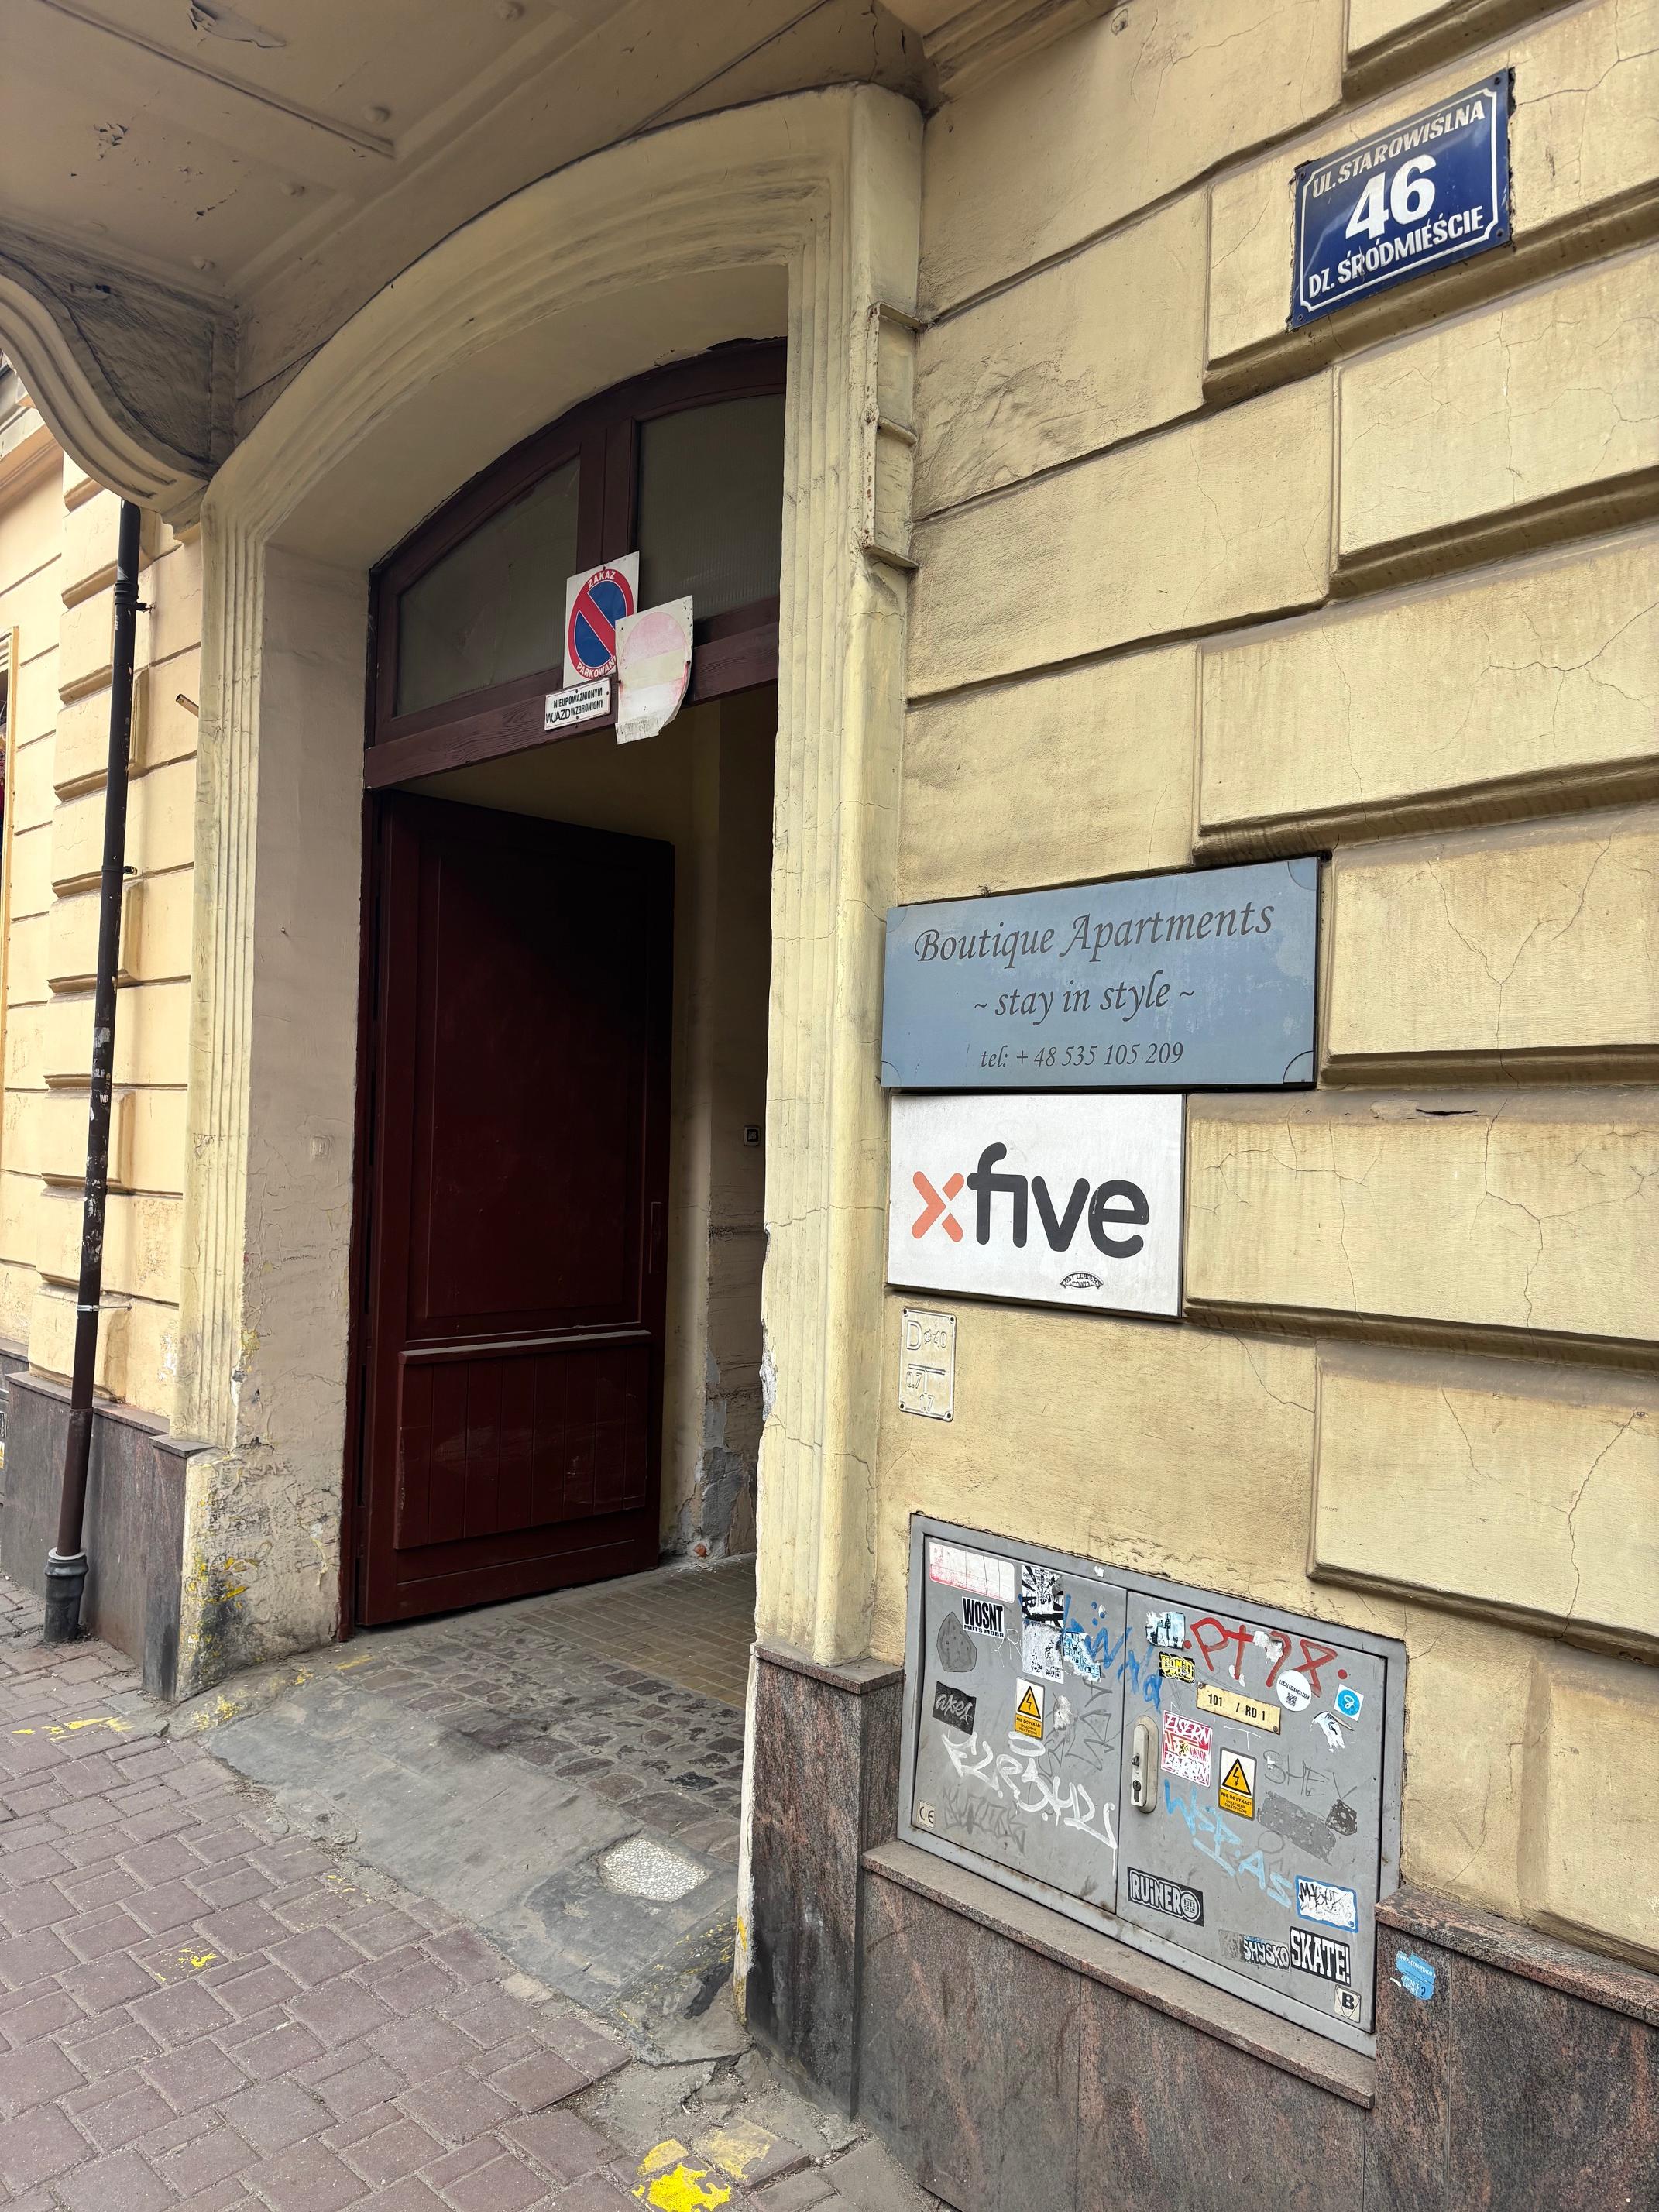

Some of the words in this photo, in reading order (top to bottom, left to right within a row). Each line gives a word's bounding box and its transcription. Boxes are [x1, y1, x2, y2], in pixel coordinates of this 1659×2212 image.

[1312, 175, 1336, 199] UL.
[1338, 100, 1486, 184] STAROWIŚLNA
[1345, 154, 1437, 240] 46
[1308, 271, 1335, 299] DZ.
[1338, 205, 1484, 284] ŚRÓDMIEŚCIE
[587, 571, 616, 589] ZAKAZ
[576, 655, 617, 678] PARKOWAN
[553, 687, 603, 709] NIEUPOWAŻNIONYM
[545, 708, 571, 723] WJAZD
[915, 921, 1054, 970] Boutique
[1059, 901, 1275, 963] Apartments
[994, 990, 1053, 1026] stay
[1063, 979, 1091, 1012] in
[1098, 970, 1170, 1022] style
[1033, 1048, 1056, 1067] 48
[1061, 1045, 1096, 1066] 535
[1104, 1044, 1139, 1065] 105
[1145, 1042, 1183, 1066] 209
[912, 1142, 1150, 1259] xfive
[907, 1320, 922, 1351] D
[963, 1597, 1004, 1633] WOSNT
[963, 1624, 983, 1633] MUTS
[984, 1628, 1005, 1638] MOBB
[1208, 1694, 1222, 1707] 101
[1245, 1705, 1257, 1719] RD
[1261, 1711, 1266, 1721] 1
[1243, 1939, 1290, 1968] SHYSKO
[1290, 1928, 1351, 1984] SKATE!
[1341, 1991, 1355, 2010] B
[1420, 1986, 1426, 1998] ?
